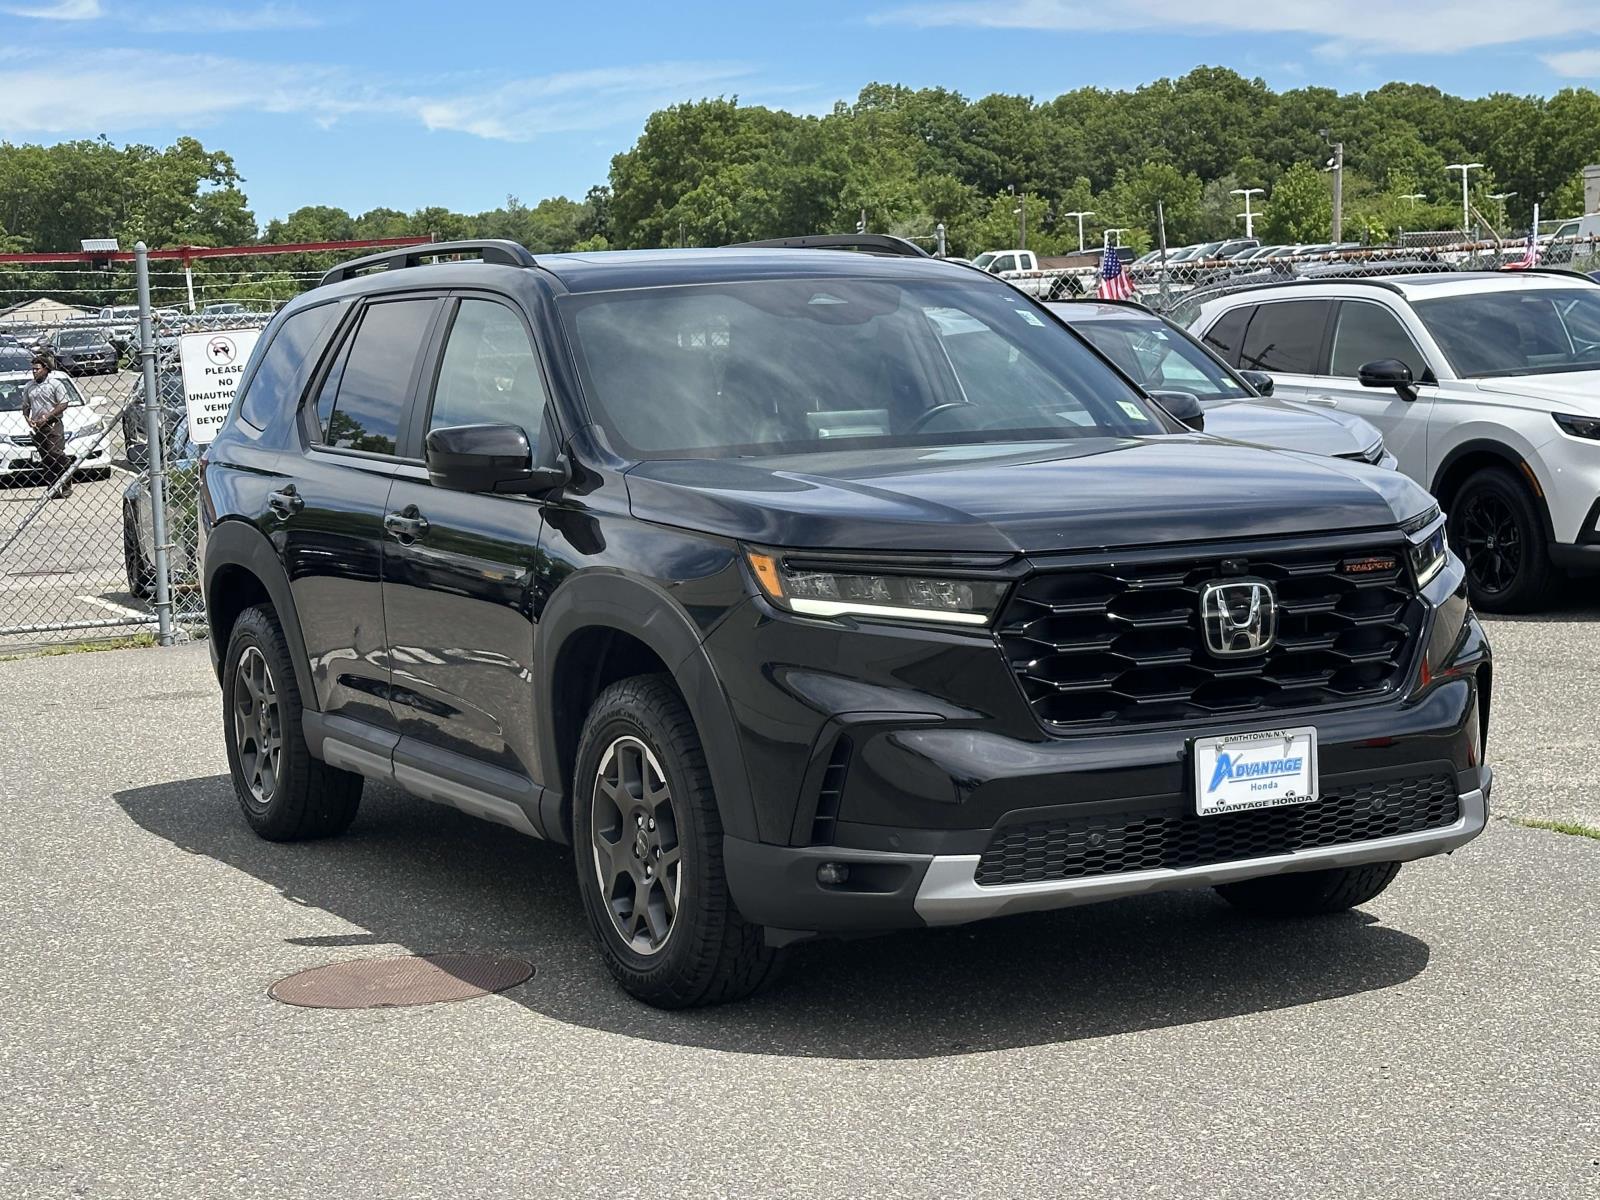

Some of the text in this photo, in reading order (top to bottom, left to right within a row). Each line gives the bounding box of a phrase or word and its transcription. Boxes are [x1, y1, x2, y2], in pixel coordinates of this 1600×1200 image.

[205, 365, 243, 375] PLEASE
[1207, 753, 1303, 793] ADVANTAGE
[1250, 781, 1279, 791] Honda
[1202, 795, 1313, 815] ADVANTAGE HONDA
